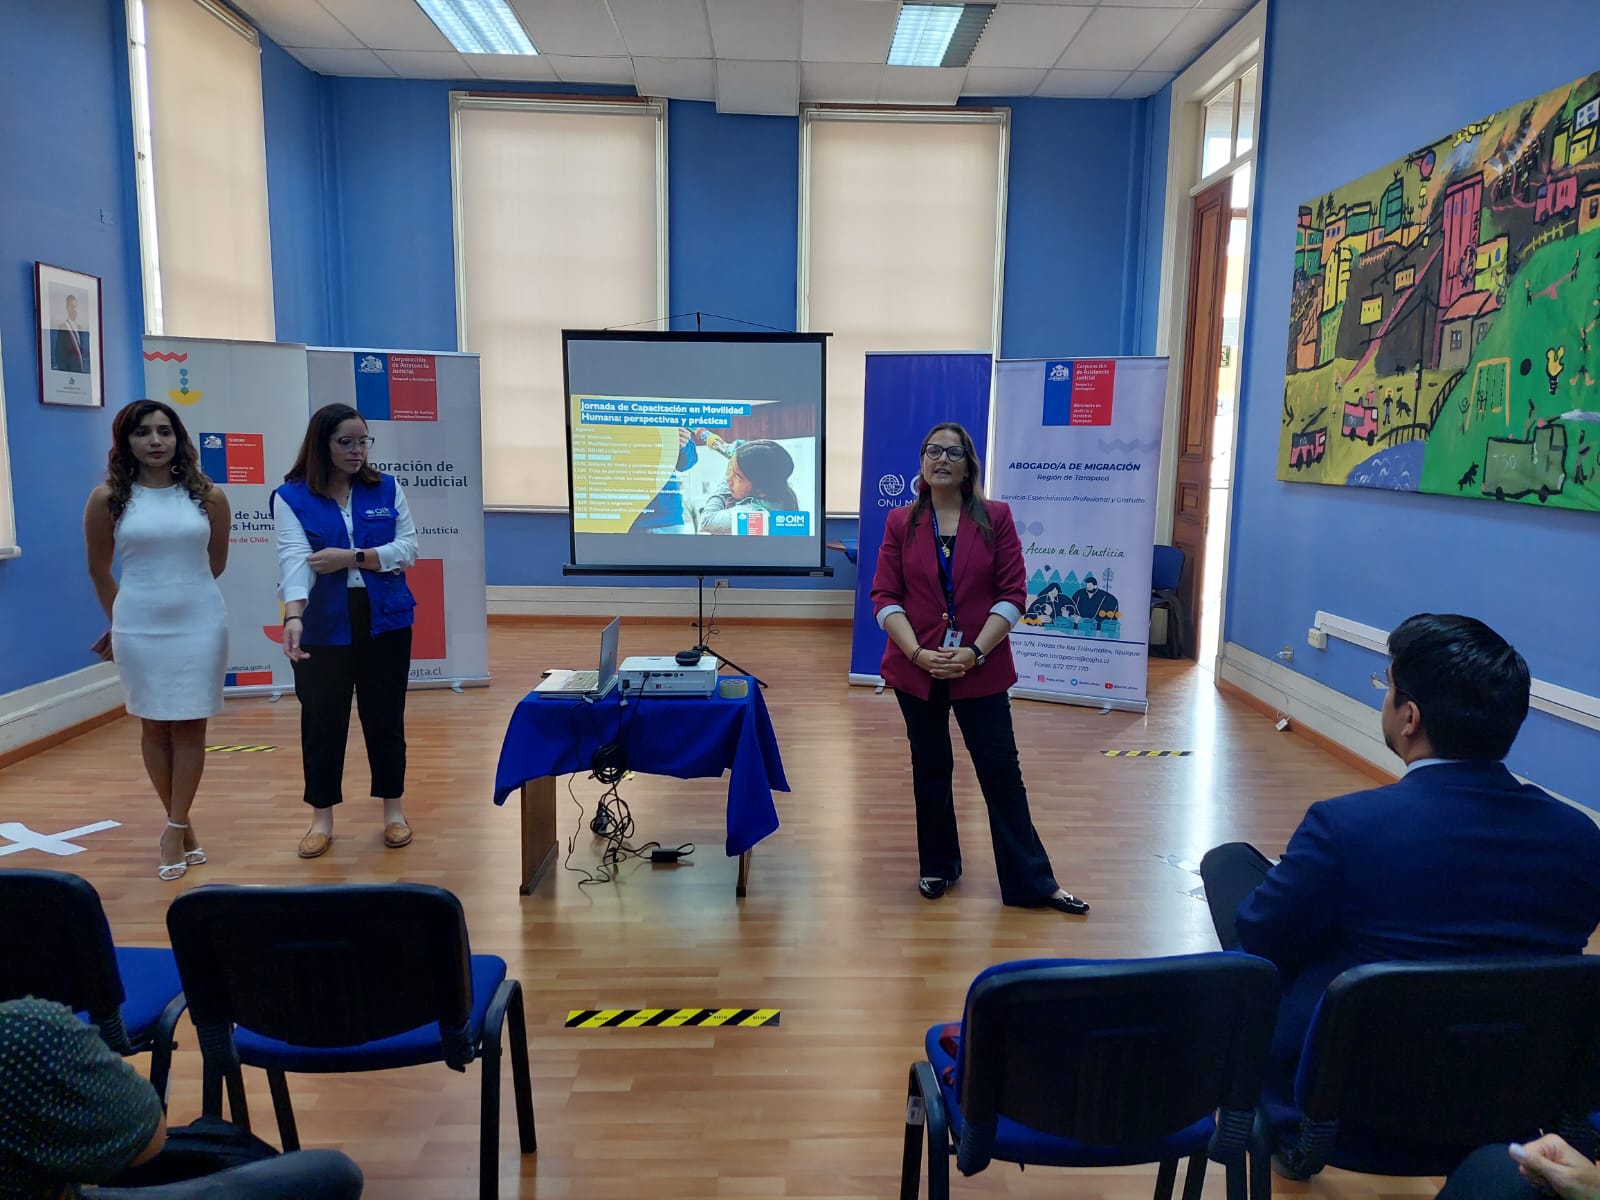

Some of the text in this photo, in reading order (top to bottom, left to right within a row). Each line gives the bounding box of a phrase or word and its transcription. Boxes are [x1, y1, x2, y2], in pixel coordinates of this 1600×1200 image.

[581, 401, 744, 415] Jornada de Capacitación en Movilidad
[581, 412, 728, 426] Humana: perspectivas y prácticas
[436, 461, 454, 472] de
[1008, 461, 1141, 472] ABOGADO/A DE MIGRACIÓN
[413, 475, 468, 487] Judicial
[1037, 473, 1062, 482] Región
[878, 499, 901, 507] ONU
[234, 510, 250, 520] de
[785, 515, 805, 524] OIM
[420, 526, 459, 535] Justicia
[1025, 541, 1125, 558] Acceso a la Justicia
